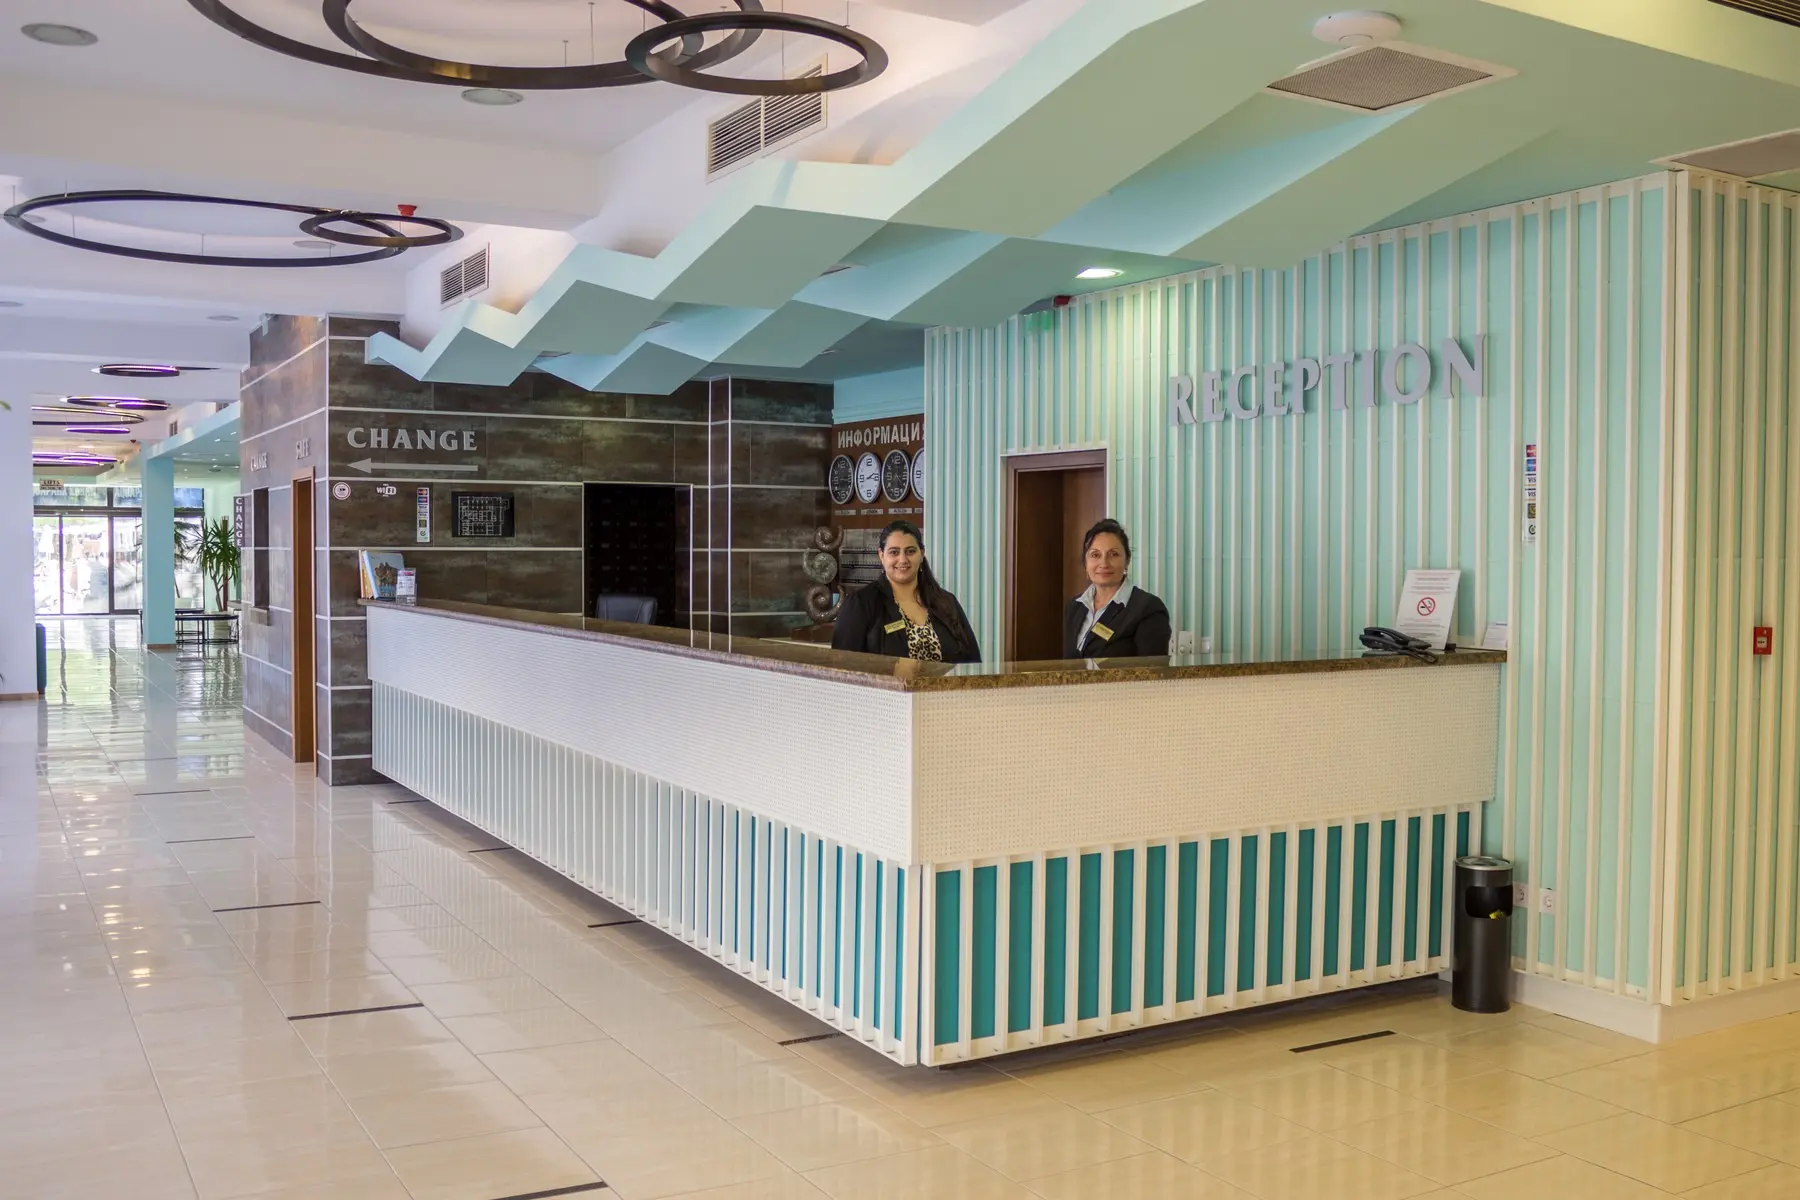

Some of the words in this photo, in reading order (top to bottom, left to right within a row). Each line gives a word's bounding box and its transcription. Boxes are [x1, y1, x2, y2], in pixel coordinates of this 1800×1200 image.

[1169, 333, 1486, 426] RECEPTION
[296, 438, 311, 460] SAFE
[347, 427, 478, 451] CHANGE
[235, 498, 244, 547] CHANGE
